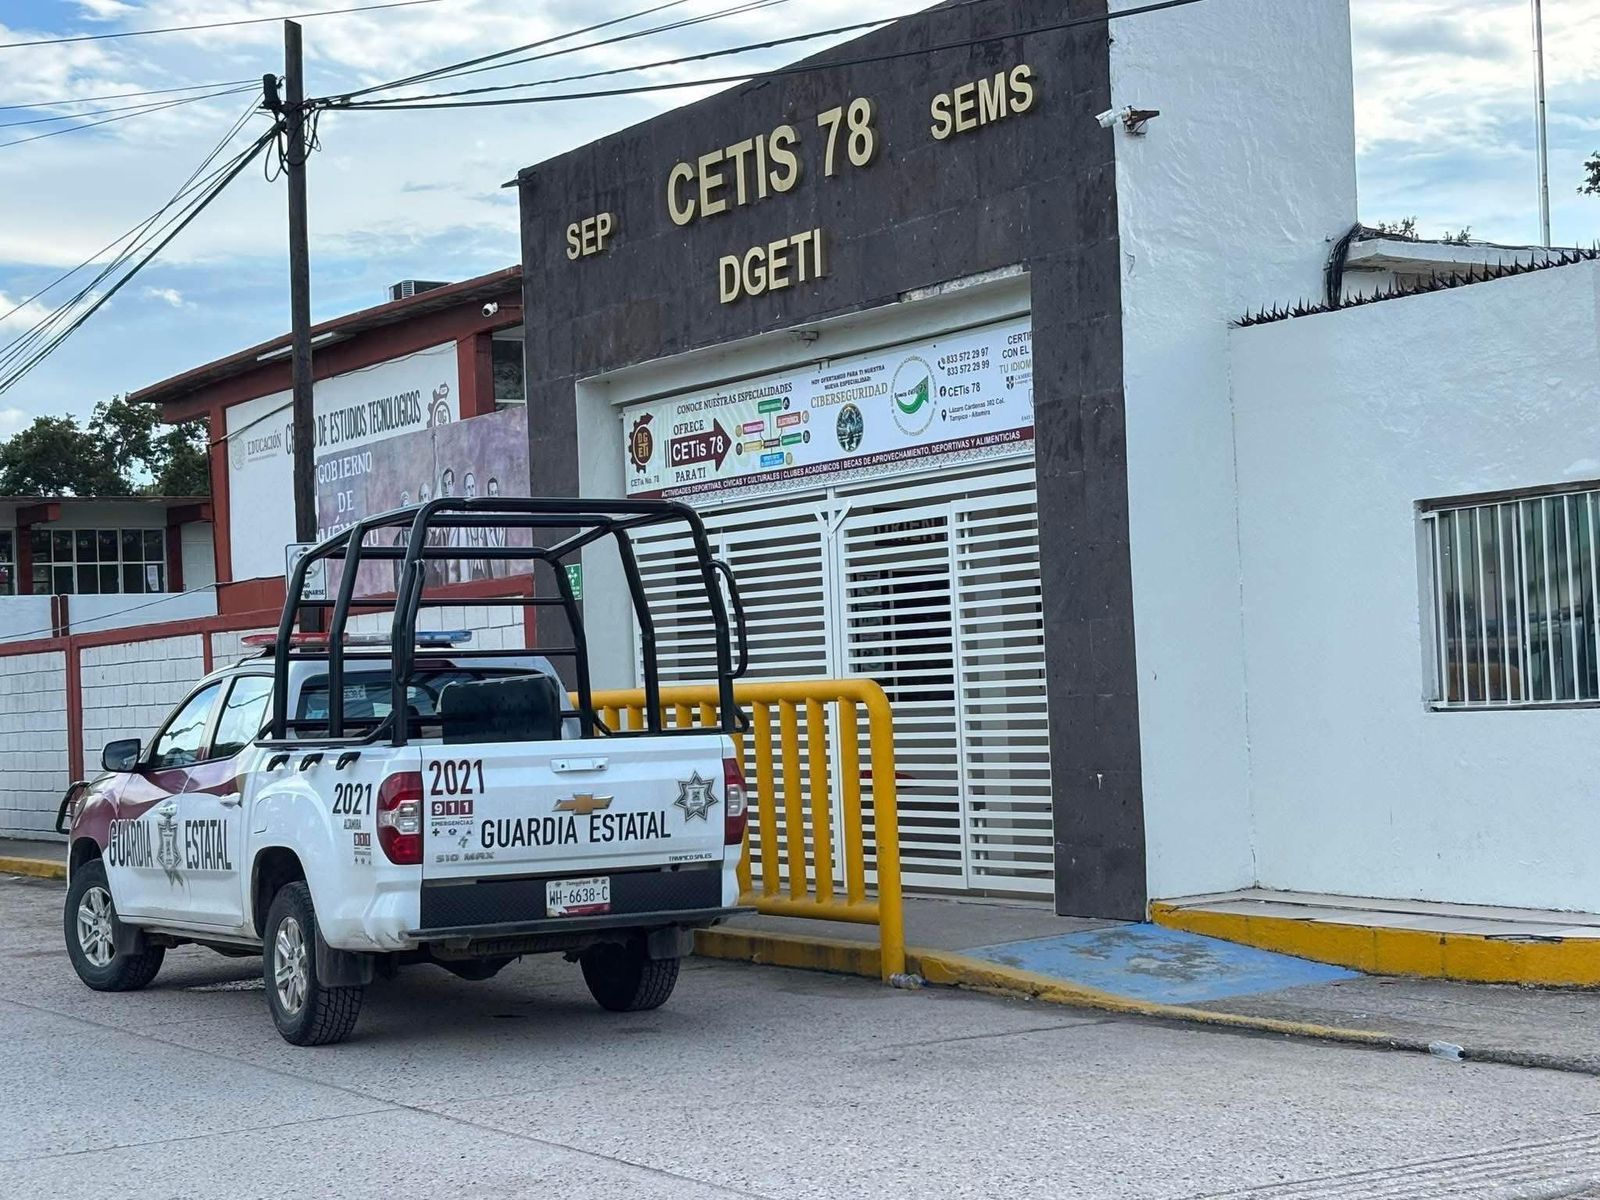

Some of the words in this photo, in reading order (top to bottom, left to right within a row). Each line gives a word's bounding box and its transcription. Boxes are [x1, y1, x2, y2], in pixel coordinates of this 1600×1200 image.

[930, 64, 1035, 140] SEMS
[667, 125, 801, 226] CETIS
[818, 97, 877, 177] 78
[566, 212, 615, 260] SEP
[719, 228, 824, 304] DGETI
[981, 347, 989, 357] 97
[1002, 347, 1018, 359] CON
[1020, 345, 1029, 355] EL
[1000, 363, 1009, 374] TU
[677, 401, 702, 415] CONOCE
[704, 395, 736, 409] NUESTRAS
[738, 382, 793, 403] ESPECIALIDADES
[811, 382, 888, 409] CIBERSEGURIDAD
[971, 382, 981, 393] 78
[318, 414, 327, 446] DE
[330, 402, 367, 444] ESTUDIOS
[368, 390, 421, 435] TECNOLOGICOS
[673, 420, 704, 435] OFRECE
[248, 429, 281, 455] EDUCACIÓN
[637, 432, 648, 442] DG
[673, 440, 707, 461] CETis
[710, 436, 724, 455] 78
[844, 458, 862, 468] BECAS
[863, 457, 871, 465] DE
[932, 440, 969, 454] DEPORTIVAS
[976, 430, 1021, 446] ALIMENTICIAS
[318, 451, 372, 484] GOBIERNO
[675, 469, 697, 482] PARA
[697, 467, 706, 478] TI
[783, 468, 804, 479] CLUBES
[661, 486, 691, 498] ACTIVIDADES
[747, 471, 780, 484] CULTURALES
[337, 490, 354, 513] DE
[429, 759, 484, 795] 2021
[333, 783, 372, 815] 2021
[433, 801, 470, 815] 911
[431, 819, 474, 827] EMERGENCIAS
[481, 815, 578, 848] GUARDIA
[589, 810, 671, 843] ESTATAL
[109, 819, 153, 868] GUARDIA
[185, 819, 232, 870] ESTATAL
[464, 851, 495, 861] MAX
[550, 886, 608, 906] WH-6638-C
